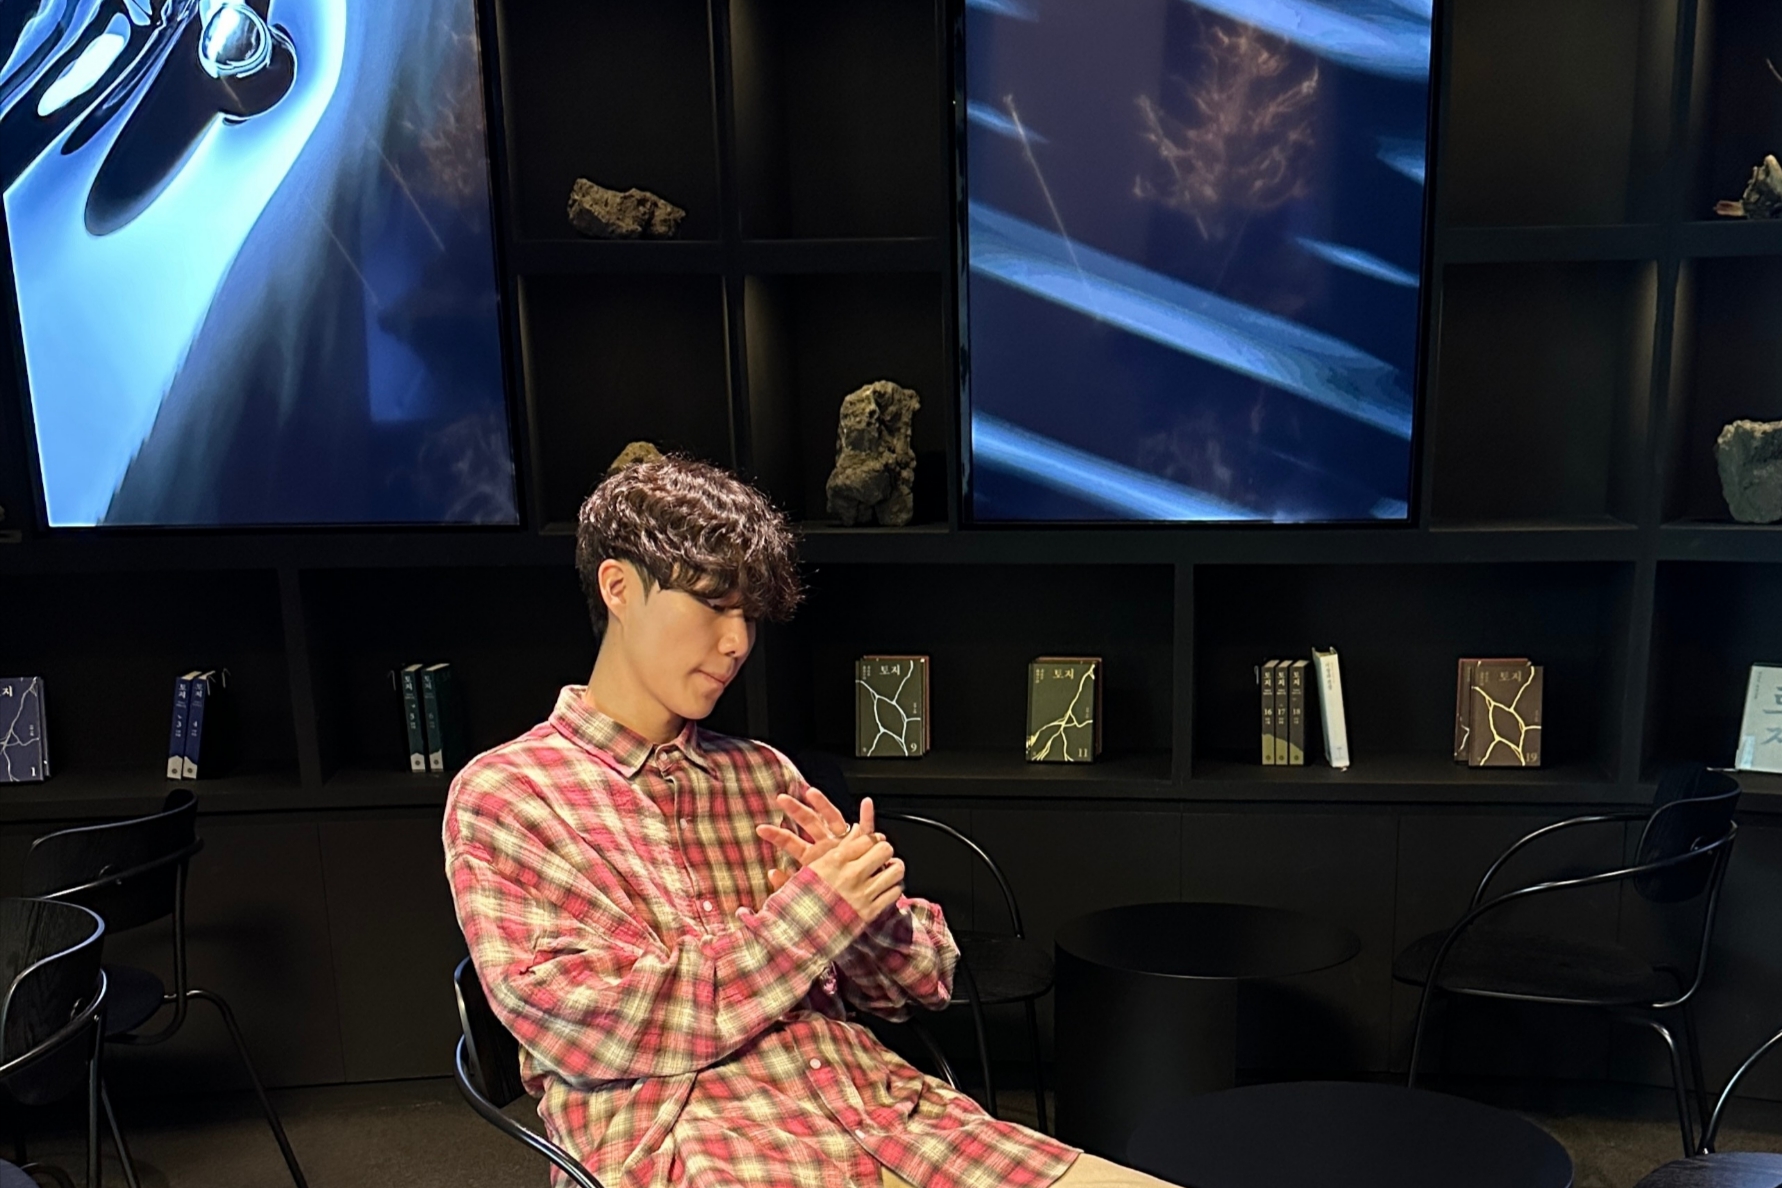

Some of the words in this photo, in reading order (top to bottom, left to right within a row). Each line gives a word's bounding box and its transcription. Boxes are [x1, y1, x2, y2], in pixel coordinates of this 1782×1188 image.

[879, 664, 900, 676] 토지
[1053, 668, 1074, 680] 토지
[1499, 670, 1522, 682] 토지
[1264, 671, 1271, 686] 토지
[1278, 671, 1285, 686] 토지
[1292, 671, 1300, 686] 토지
[0, 685, 13, 697] 지
[1264, 708, 1273, 716] 16
[1278, 708, 1286, 716] 17
[910, 743, 918, 753] 9
[1078, 748, 1088, 758] 11
[1526, 752, 1538, 763] 19
